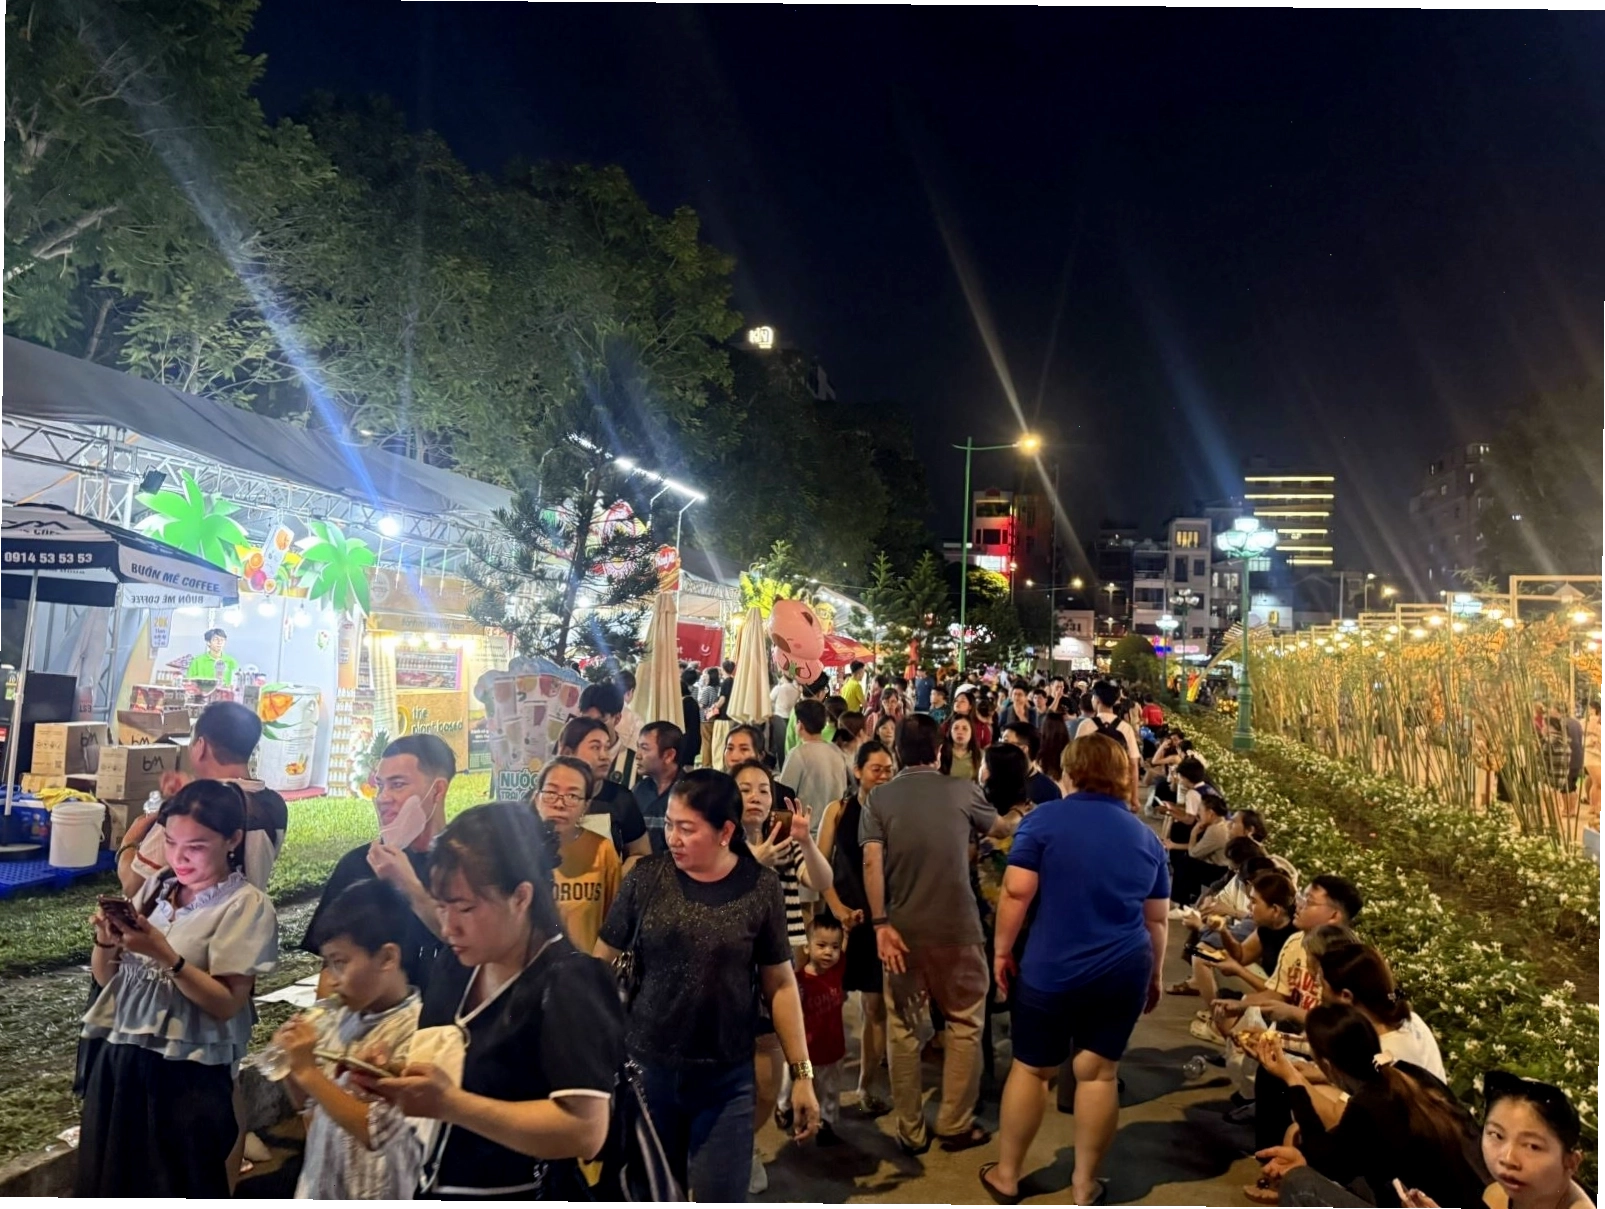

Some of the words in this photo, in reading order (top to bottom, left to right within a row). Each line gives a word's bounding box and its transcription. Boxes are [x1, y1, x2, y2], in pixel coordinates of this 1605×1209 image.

[4, 551, 36, 563] 0914
[39, 553, 56, 563] 53
[58, 553, 74, 563] 53
[77, 553, 93, 563] 53
[181, 577, 221, 592] COFFEE
